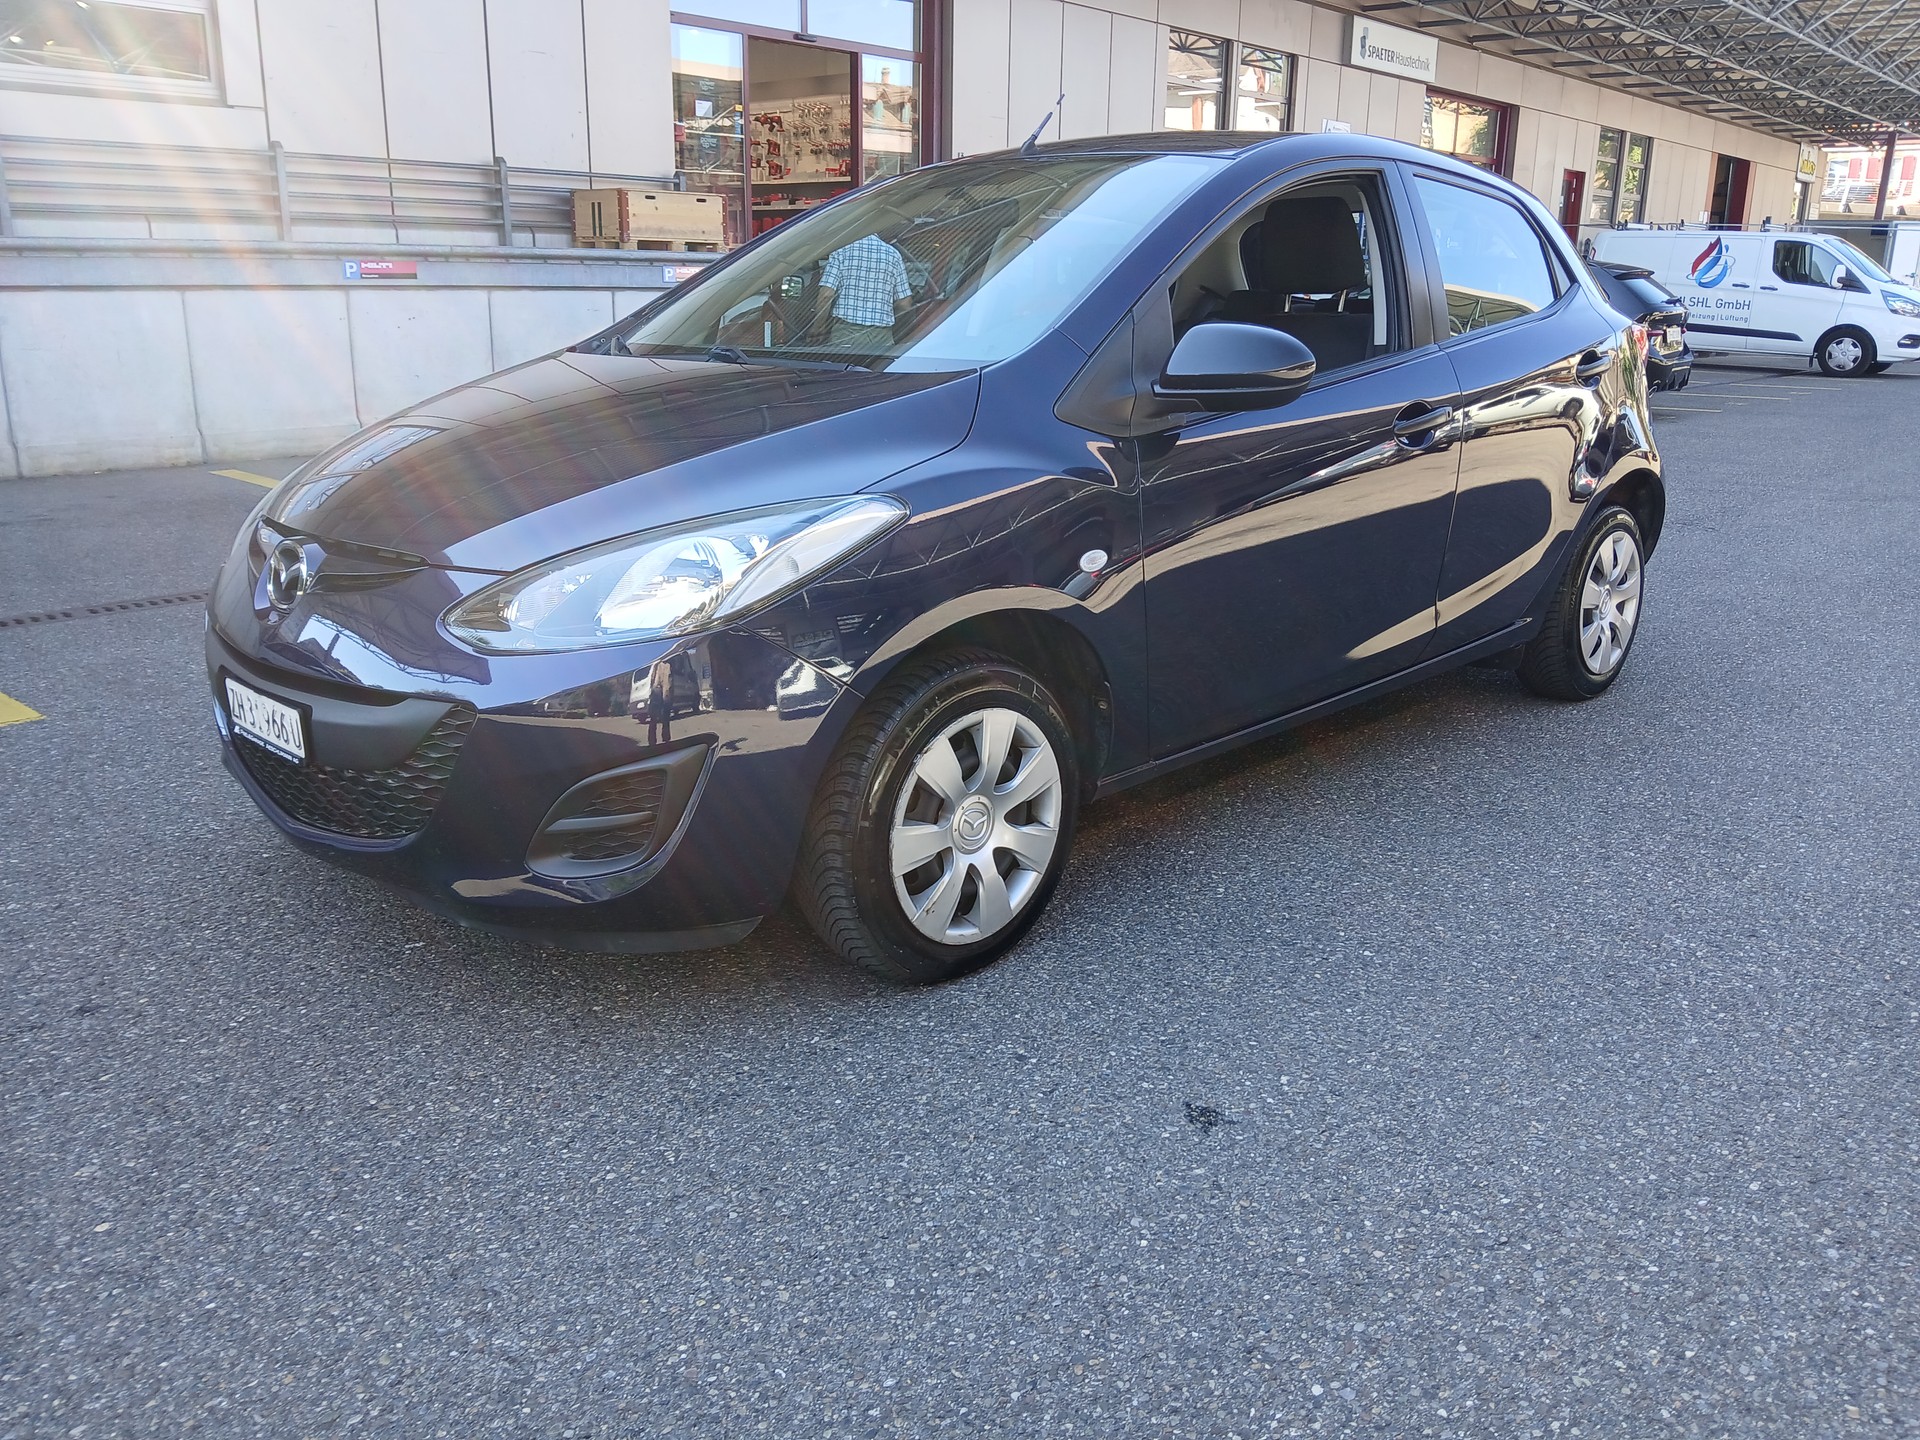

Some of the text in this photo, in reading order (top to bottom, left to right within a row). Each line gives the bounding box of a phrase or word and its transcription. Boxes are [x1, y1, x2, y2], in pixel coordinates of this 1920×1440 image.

[1367, 45, 1431, 72] SPAETER Haustechnik
[345, 262, 357, 278] P
[665, 268, 674, 281] P
[1688, 296, 1712, 309] SHL
[1715, 298, 1751, 311] GmbH
